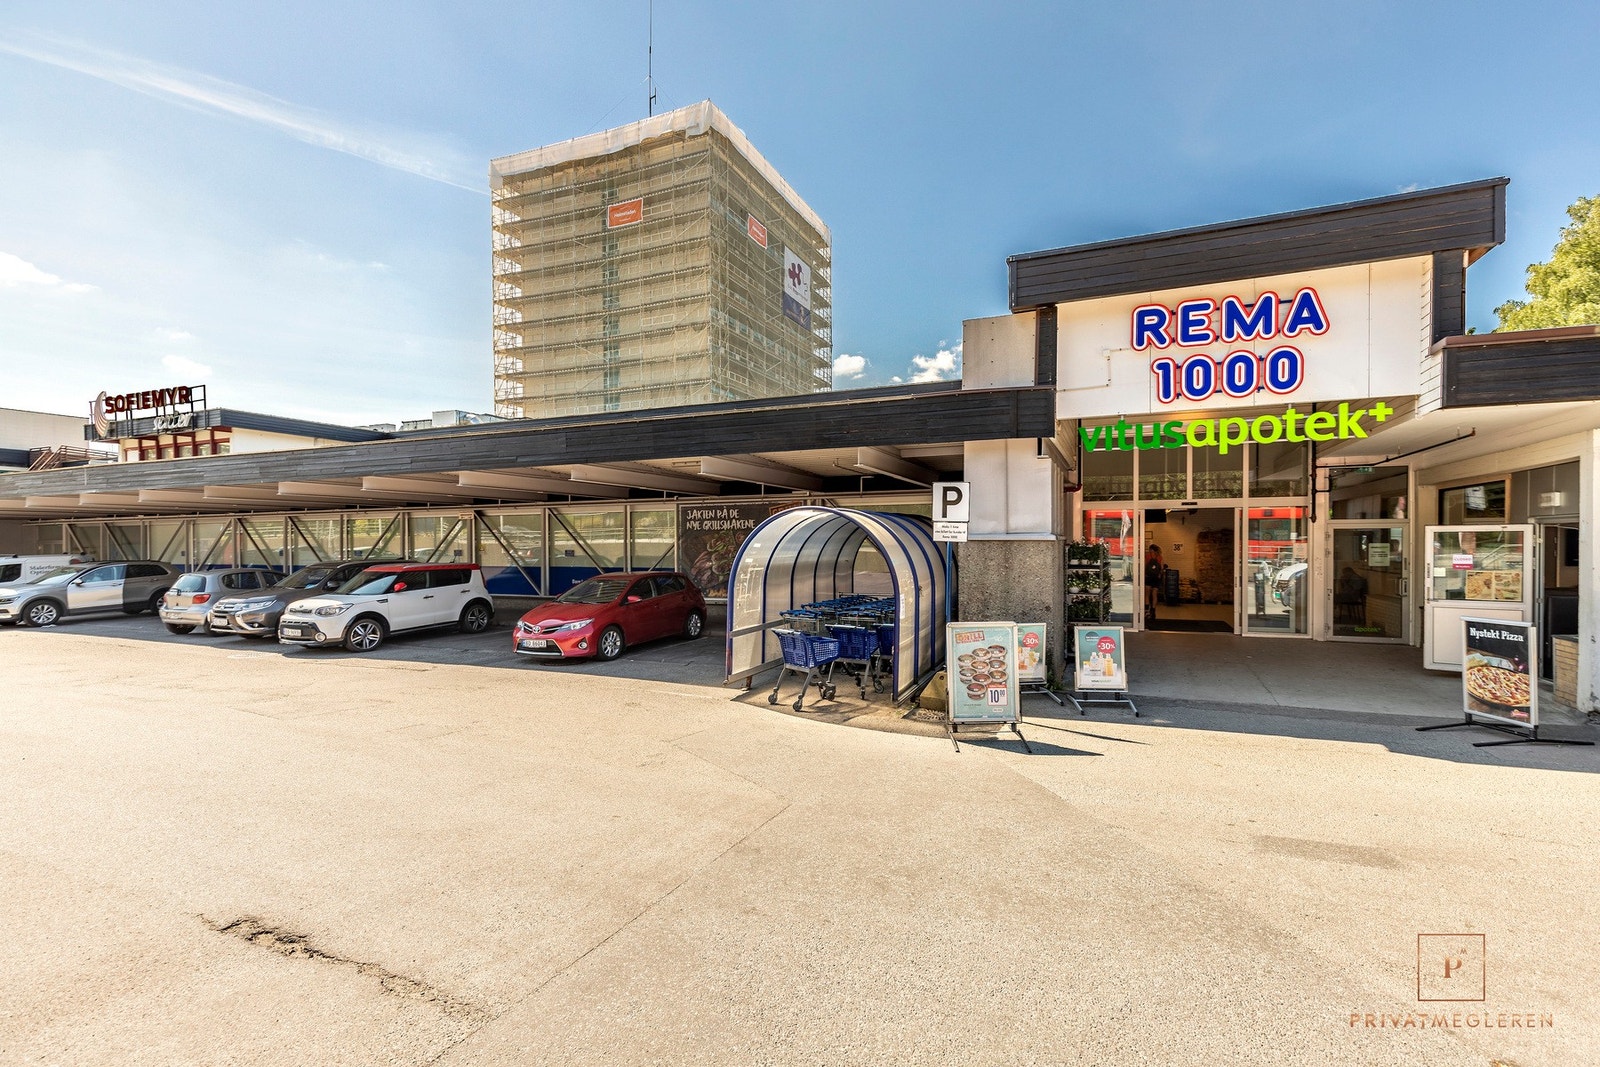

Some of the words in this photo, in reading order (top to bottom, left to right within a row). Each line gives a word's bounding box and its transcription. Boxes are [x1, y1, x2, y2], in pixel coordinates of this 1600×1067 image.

[1132, 287, 1330, 351] REMA
[1151, 345, 1304, 404] 1000
[105, 386, 191, 414] SOFIEMYR
[686, 509, 715, 519] JAKTEN
[717, 506, 728, 519] PÅ
[730, 509, 740, 519] DE
[942, 486, 963, 518] P
[686, 520, 701, 531] NYE
[703, 519, 756, 531] GRILLSMAKENE
[1469, 627, 1500, 639] Nystekt
[1501, 630, 1524, 642] Pizza
[1098, 642, 1116, 650] -30%
